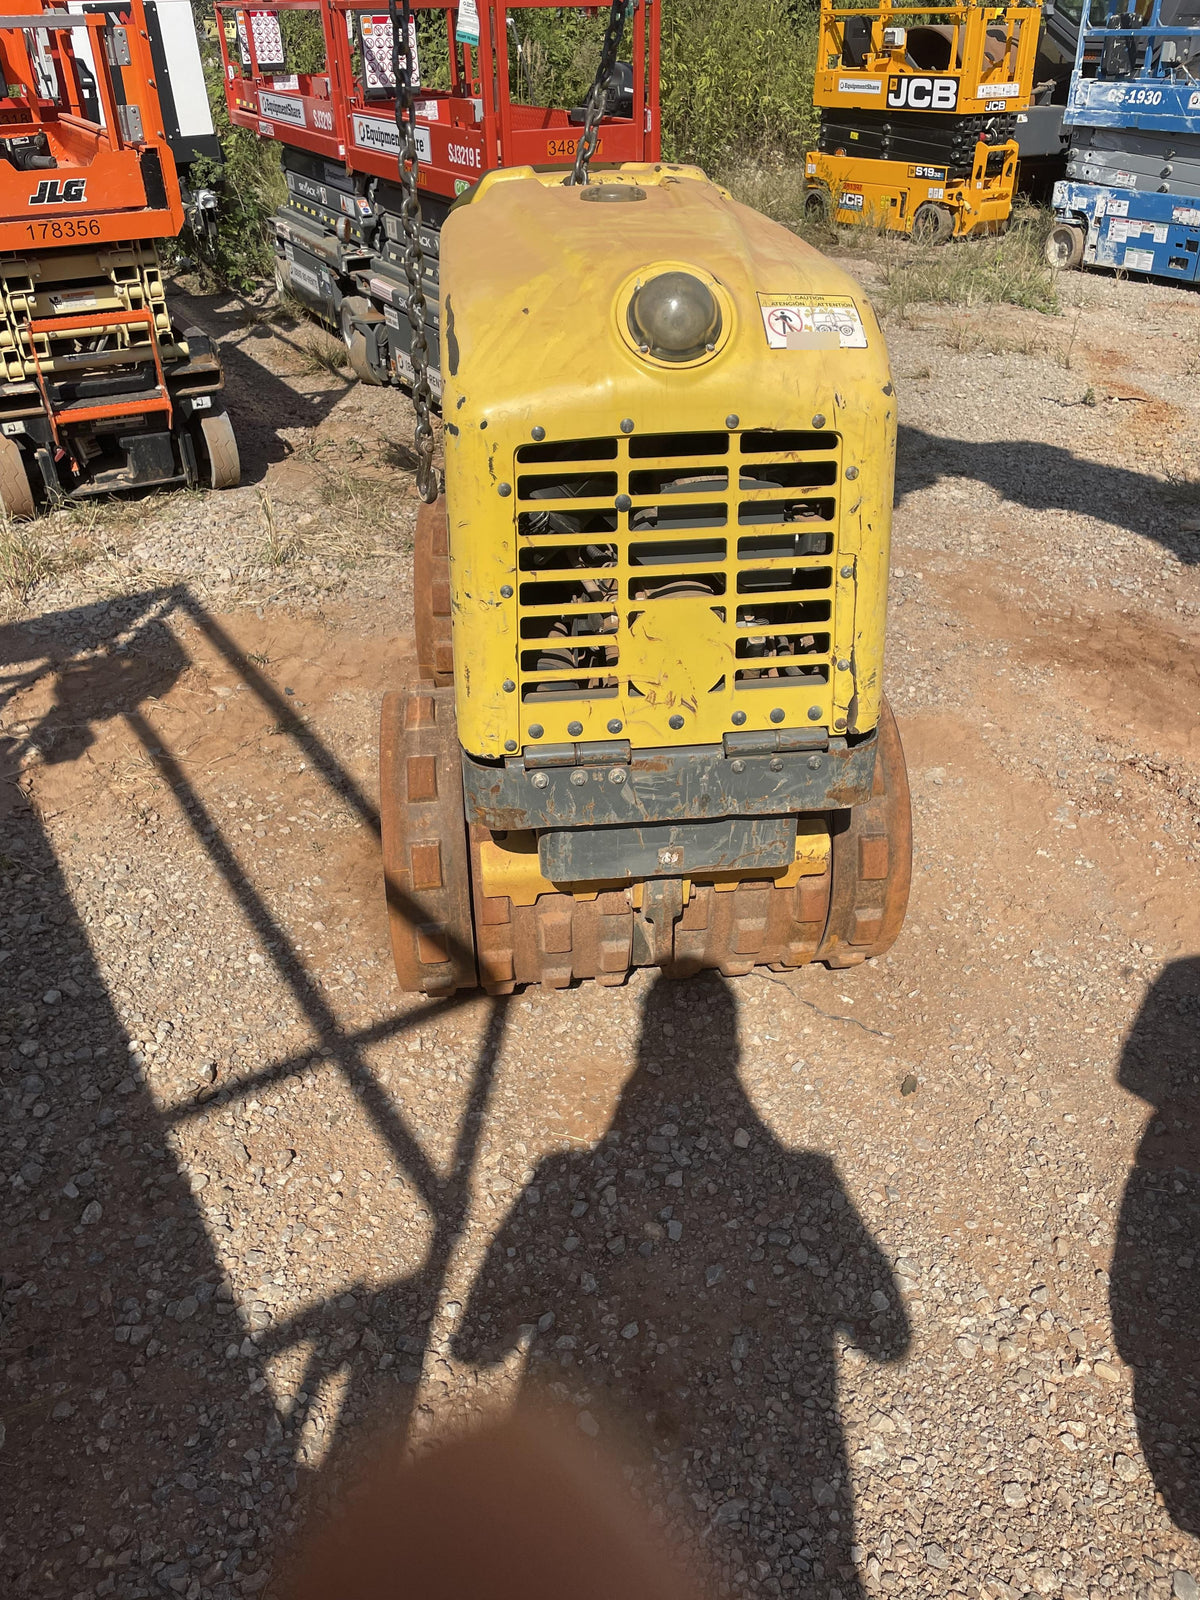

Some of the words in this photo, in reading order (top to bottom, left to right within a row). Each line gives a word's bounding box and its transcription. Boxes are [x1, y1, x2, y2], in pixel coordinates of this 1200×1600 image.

[844, 82, 880, 92] EquipmentShare
[888, 78, 958, 109] JCB
[1107, 88, 1163, 106] GS-1930
[985, 100, 1006, 111] JCB
[365, 124, 425, 153] Equipmenre
[548, 139, 602, 156] 3487
[447, 143, 475, 167] SJ3219
[475, 148, 482, 169] E
[28, 178, 88, 206] JLG
[839, 193, 863, 207] JCB
[26, 219, 101, 241] 178356
